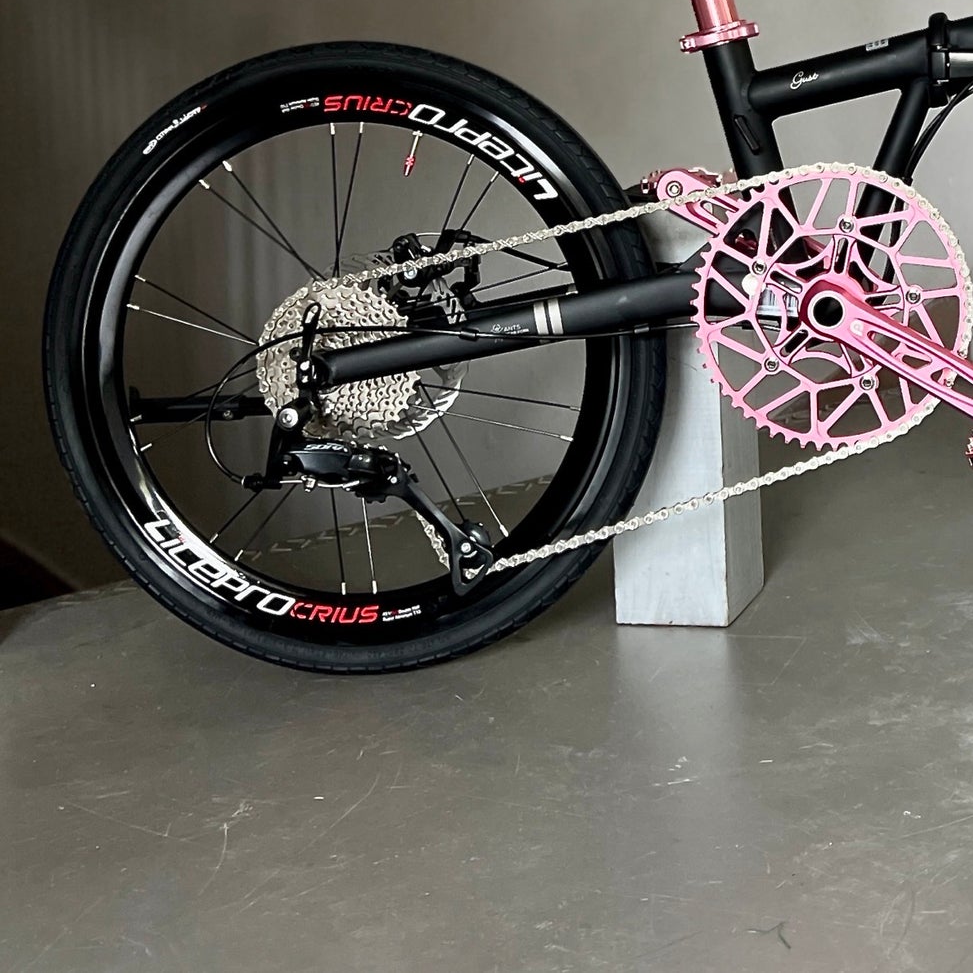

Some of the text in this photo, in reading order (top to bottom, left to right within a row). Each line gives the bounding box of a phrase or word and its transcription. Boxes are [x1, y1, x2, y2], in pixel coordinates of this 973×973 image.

[323, 95, 559, 201] Litepro CRIUS
[290, 602, 379, 624] CRIUS
